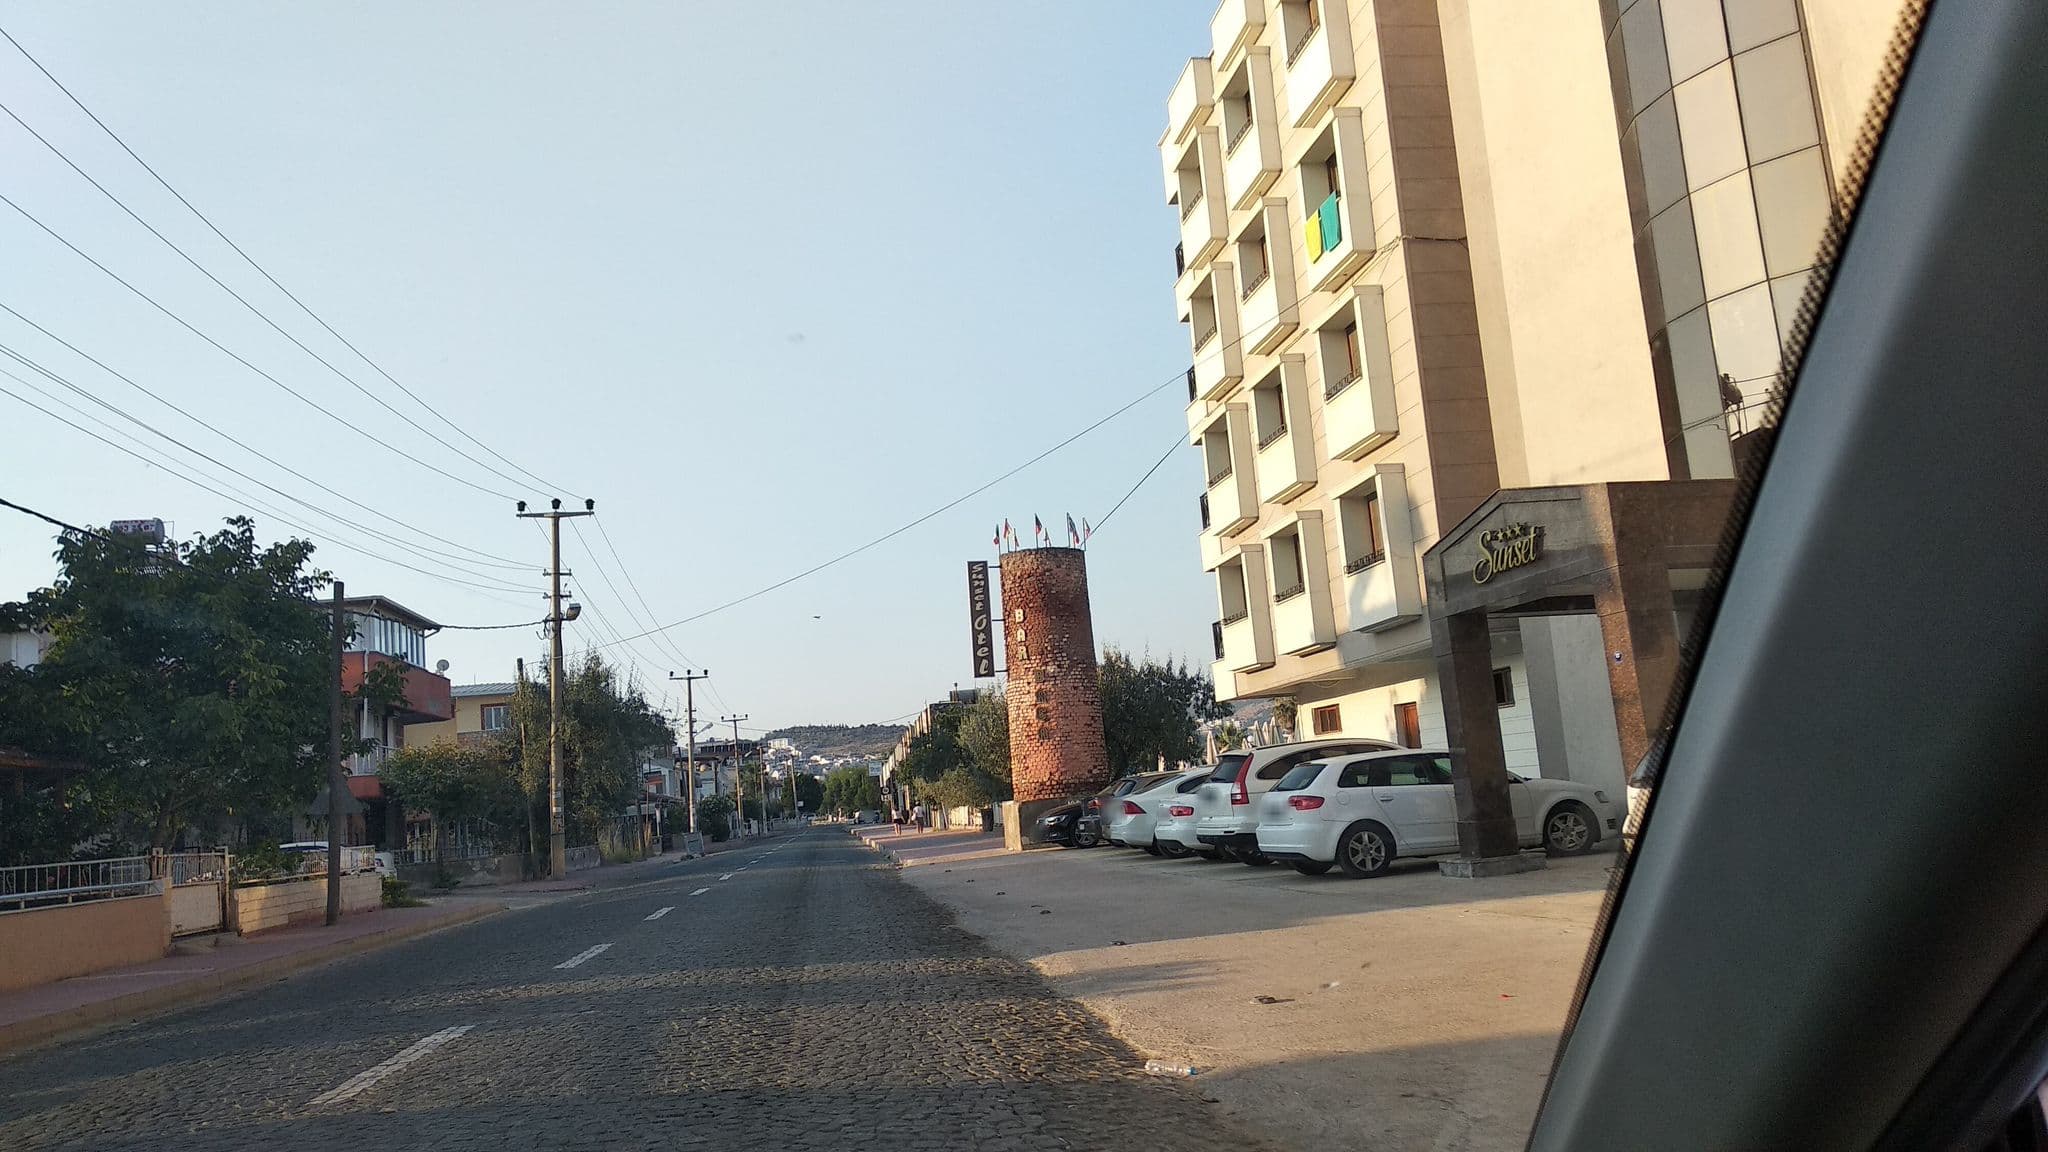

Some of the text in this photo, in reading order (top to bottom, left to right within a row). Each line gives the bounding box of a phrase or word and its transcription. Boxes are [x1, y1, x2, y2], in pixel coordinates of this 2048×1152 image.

[1472, 526, 1537, 584] Sunset
[974, 614, 990, 674] Otel
[1015, 608, 1028, 660] BAR
